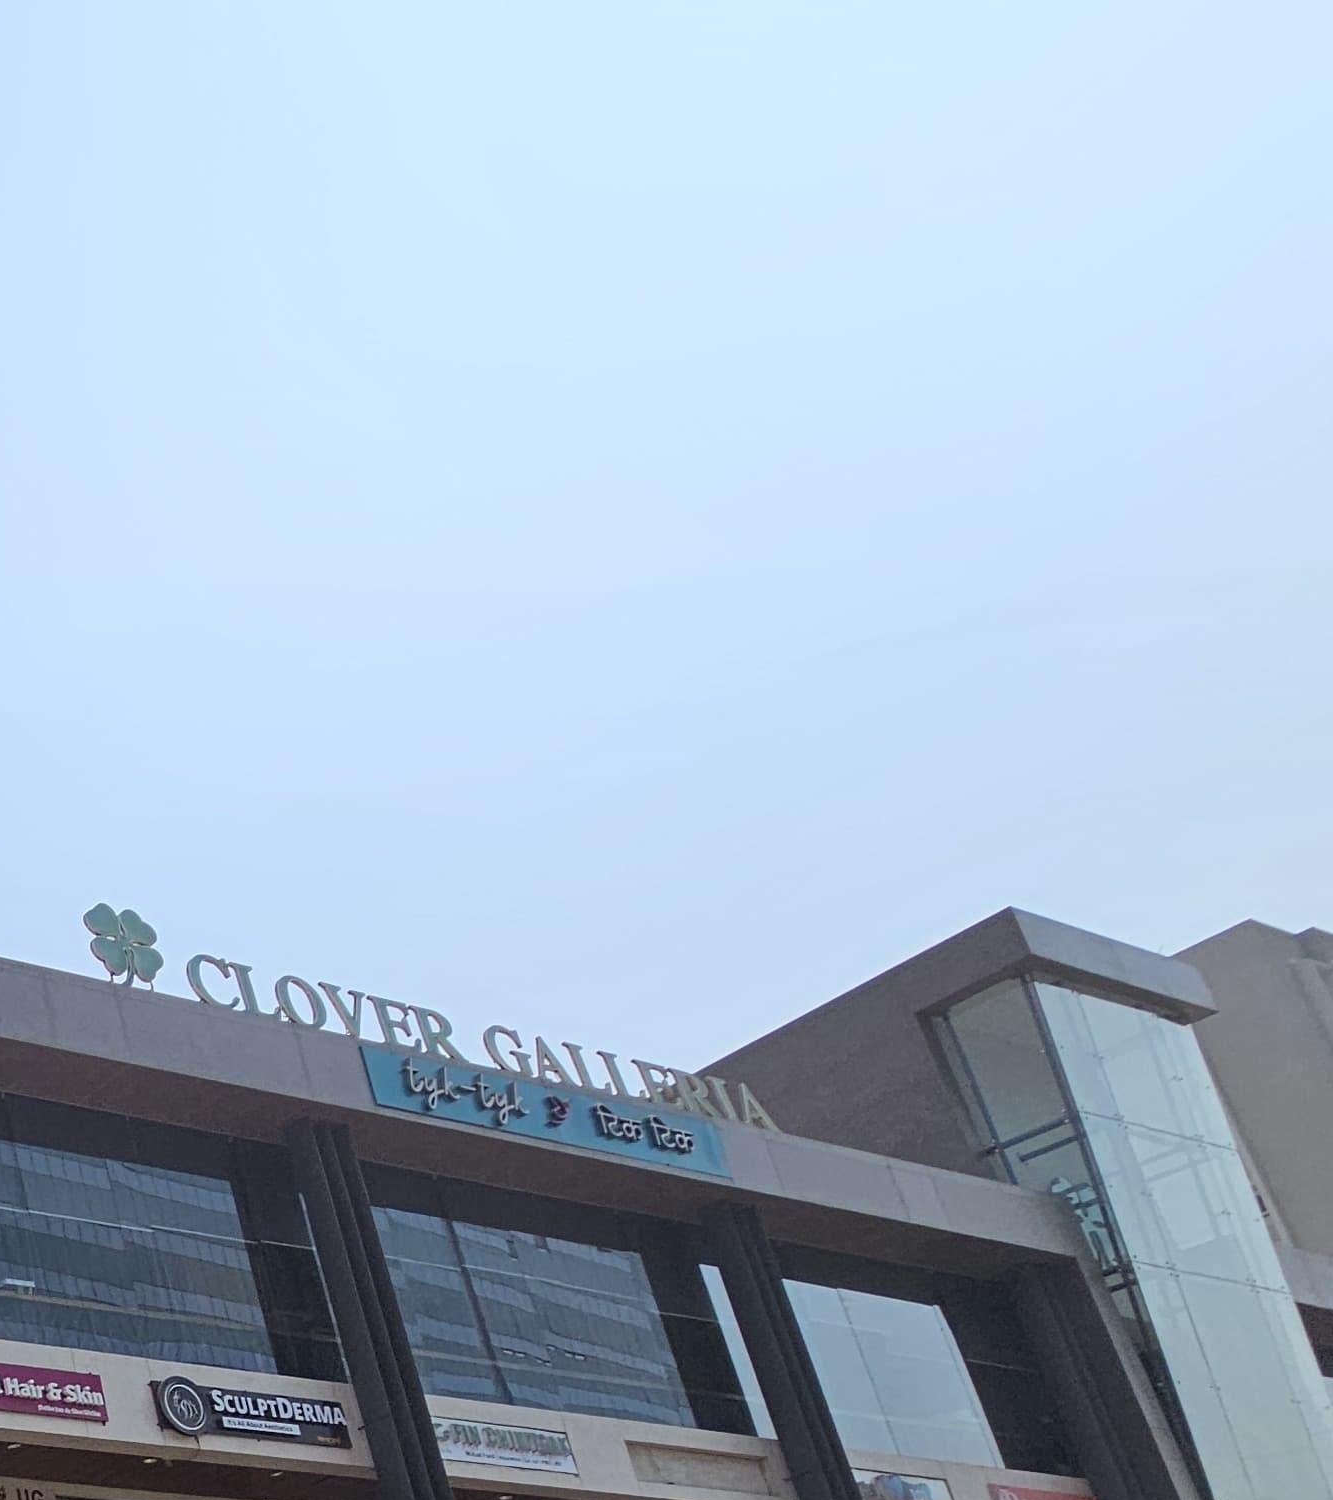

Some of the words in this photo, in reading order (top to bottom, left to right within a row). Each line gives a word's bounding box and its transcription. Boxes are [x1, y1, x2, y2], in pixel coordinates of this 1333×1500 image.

[185, 954, 469, 1062] CLOVER
[483, 1025, 784, 1134] GALLERIA
[401, 1057, 531, 1127] tyk-tyk
[4, 1377, 45, 1399] Hair
[46, 1383, 62, 1401] &
[63, 1384, 105, 1406] Skin
